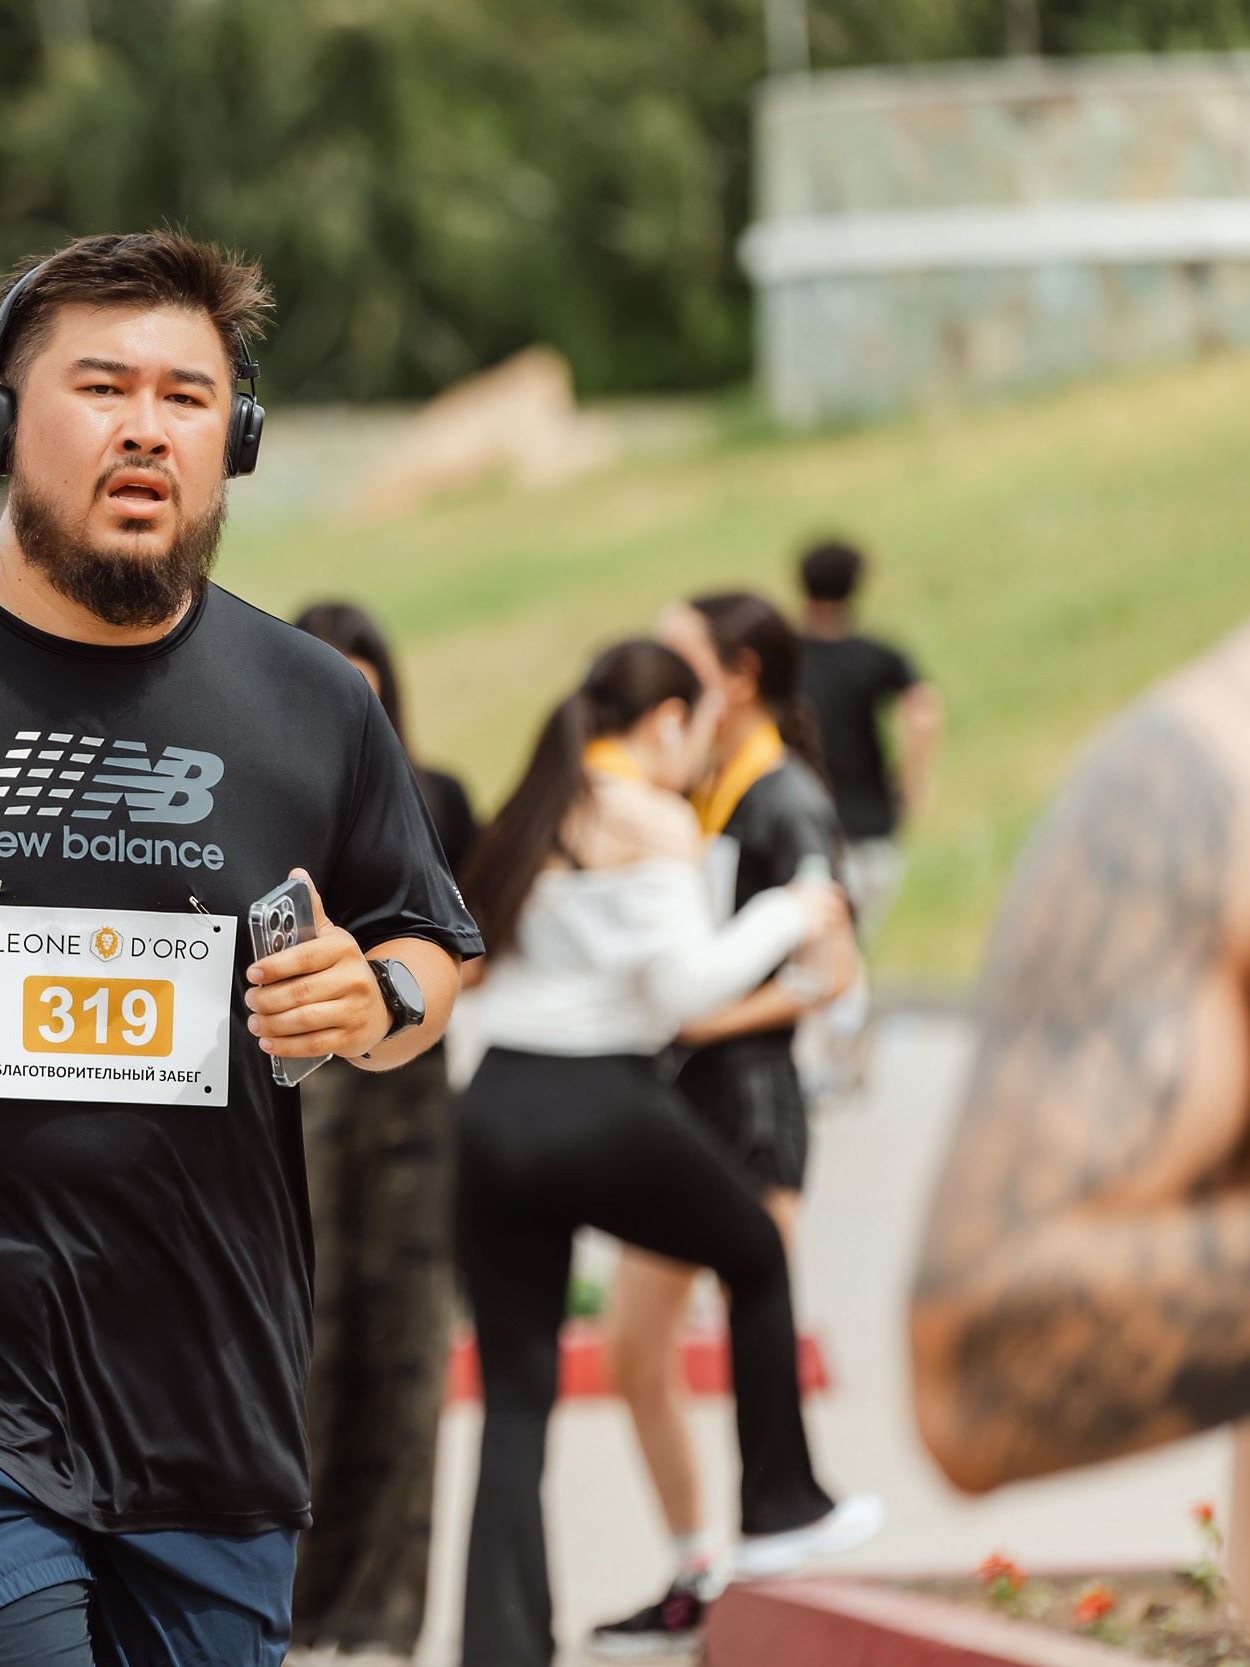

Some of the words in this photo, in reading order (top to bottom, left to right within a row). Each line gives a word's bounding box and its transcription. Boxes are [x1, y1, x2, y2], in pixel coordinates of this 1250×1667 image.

[62, 825, 225, 871] balance
[131, 937, 209, 960] D'ORO
[37, 986, 158, 1046] 319
[158, 1070, 202, 1083] ЗАБЕГ
